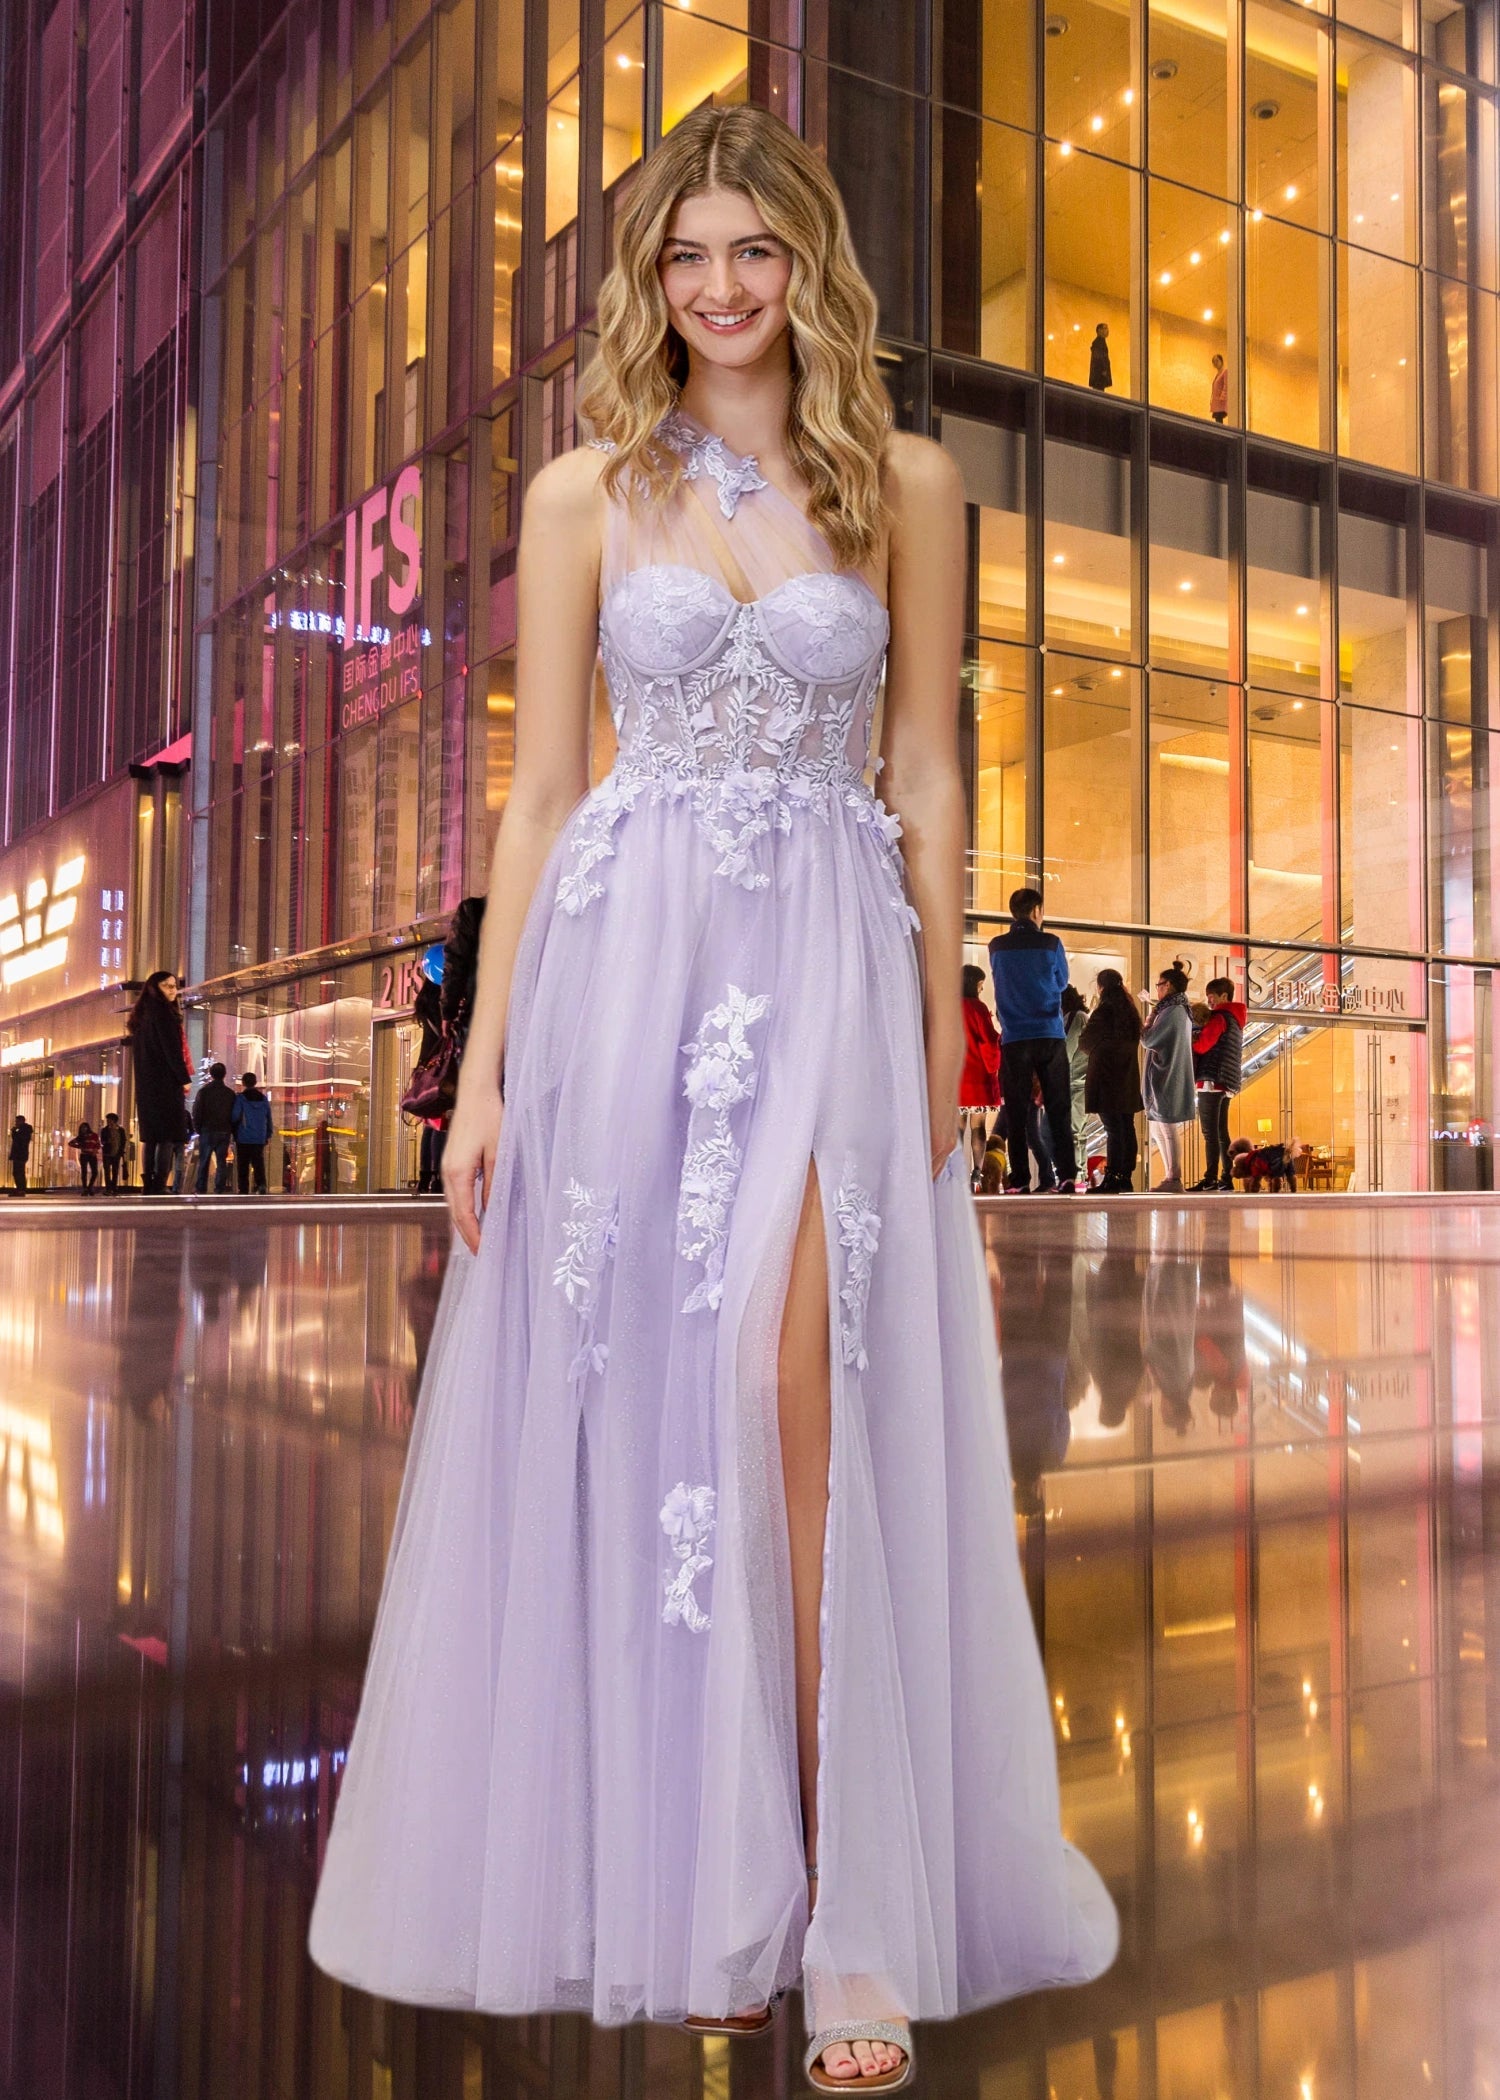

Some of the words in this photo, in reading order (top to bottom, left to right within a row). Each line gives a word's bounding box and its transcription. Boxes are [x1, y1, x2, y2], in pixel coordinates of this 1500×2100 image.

[343, 465, 421, 650] IFS
[343, 624, 418, 693] 国际金融中心
[342, 676, 397, 729] CHENGDU
[400, 665, 418, 699] IFS
[380, 966, 394, 1009] 2
[397, 960, 423, 1006] IFS
[1273, 979, 1405, 1014] 国际金融中心
